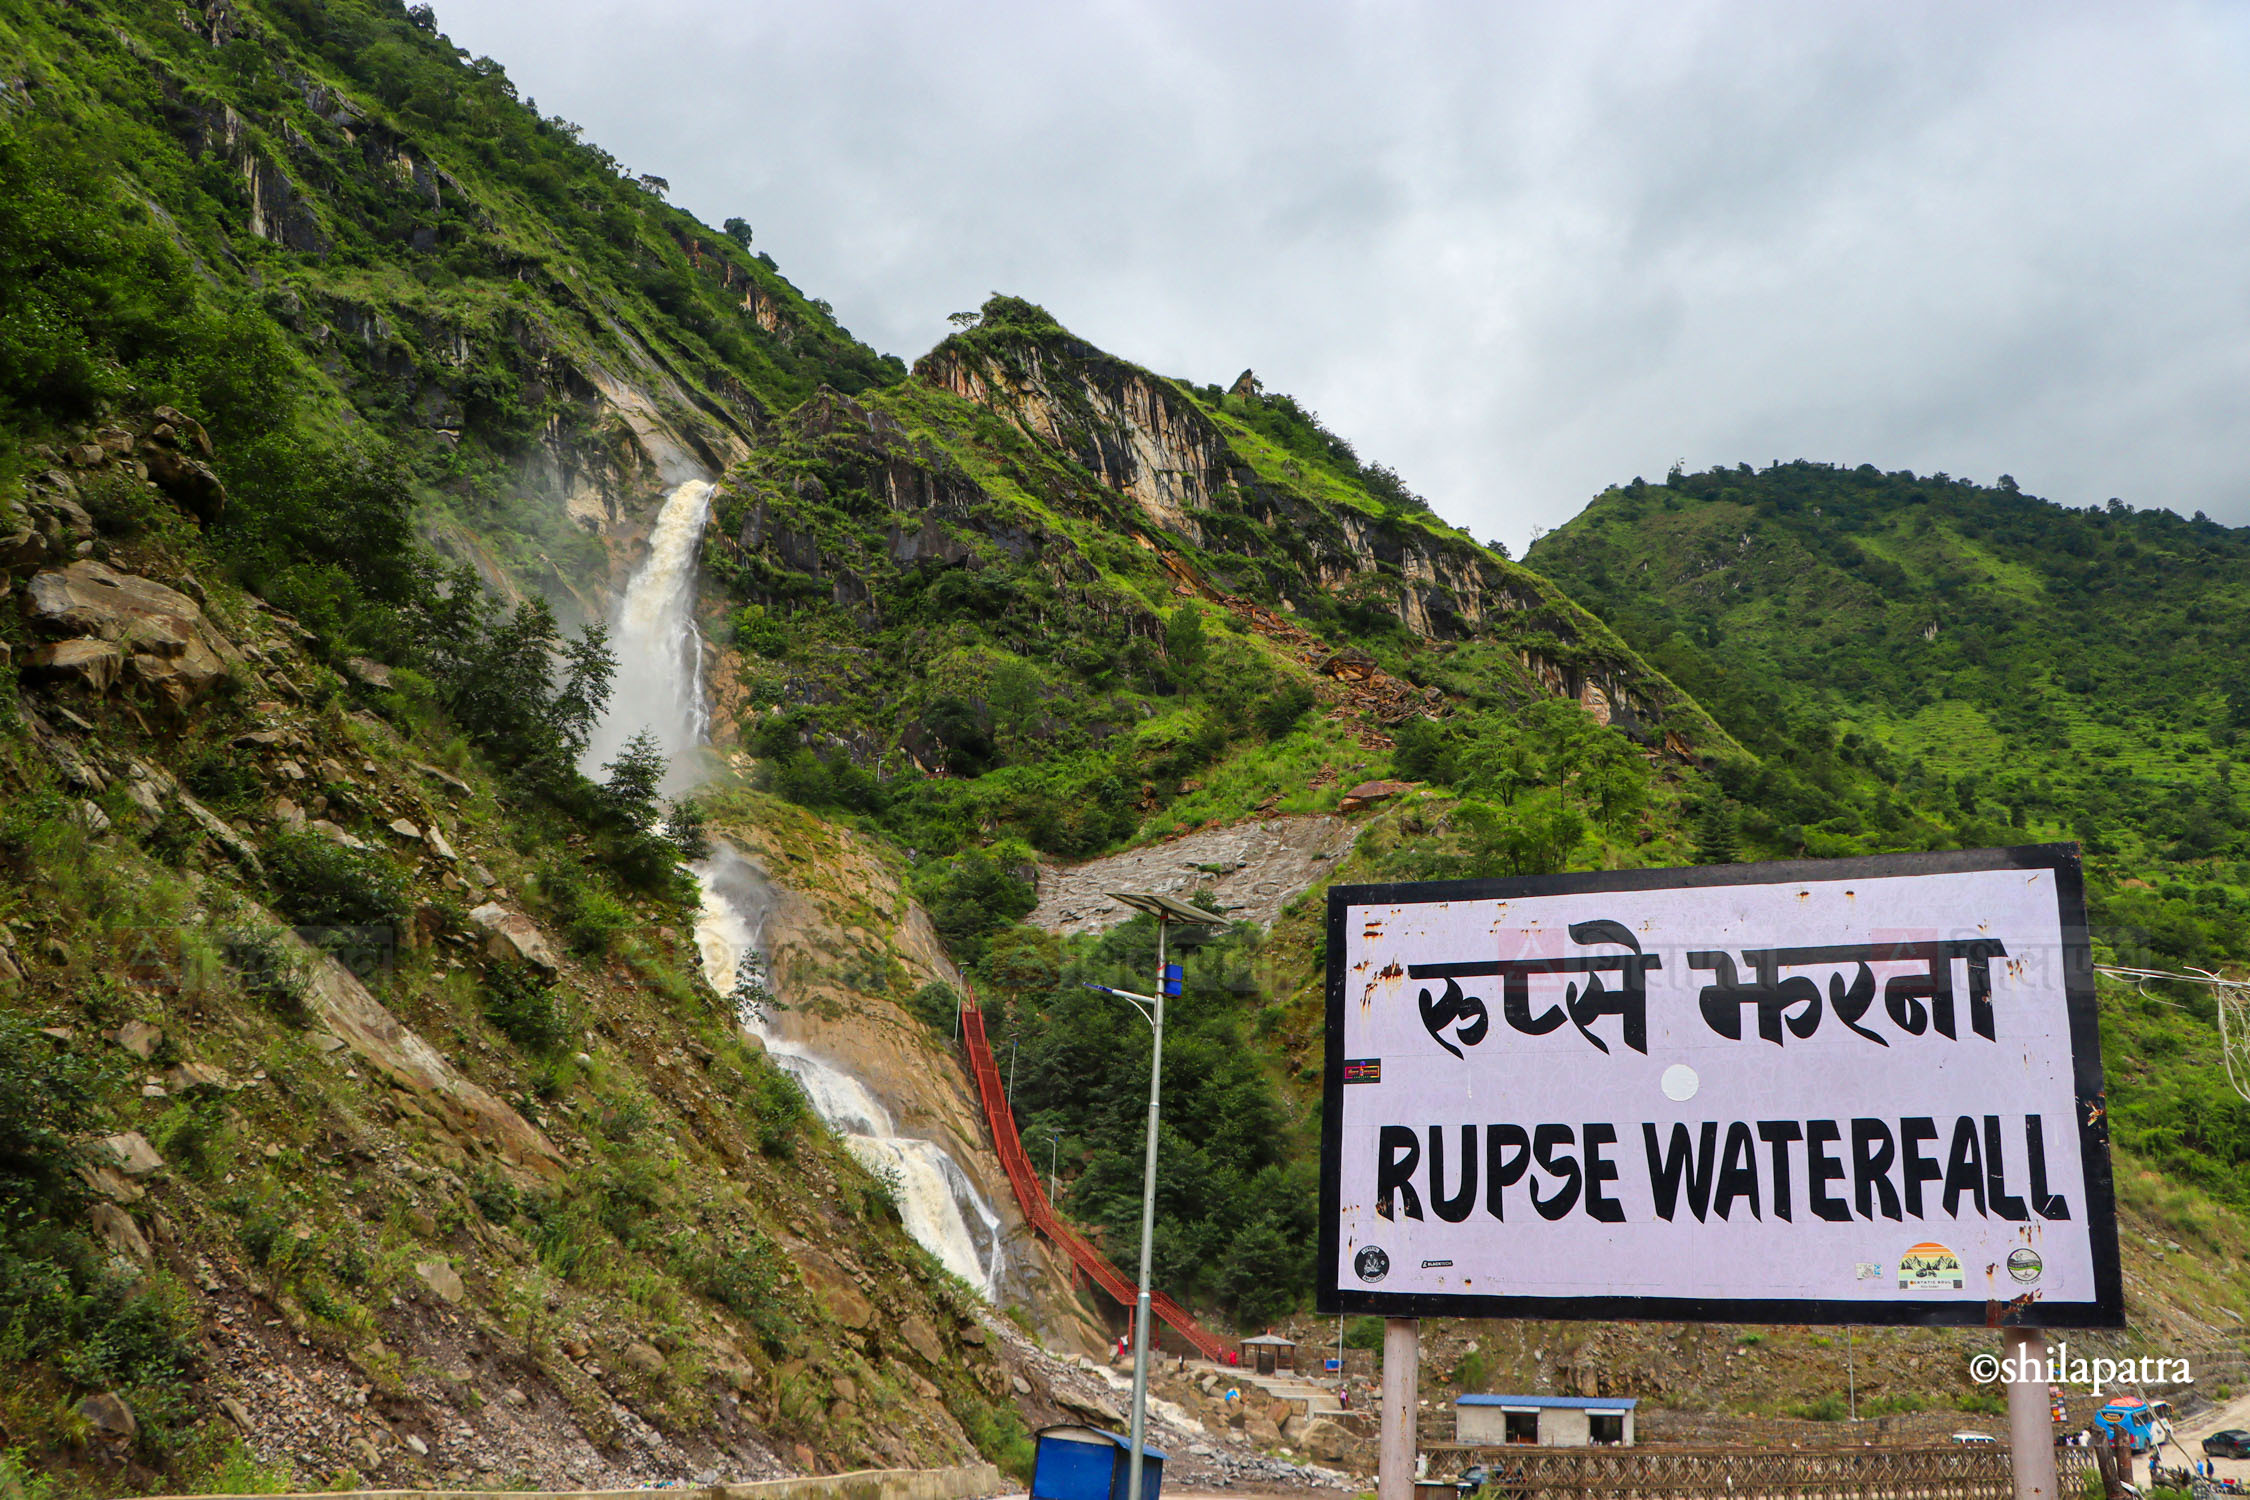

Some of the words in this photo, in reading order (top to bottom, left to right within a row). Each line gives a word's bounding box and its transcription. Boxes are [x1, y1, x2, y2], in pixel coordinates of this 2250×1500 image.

[1686, 937, 2009, 1048] झरना
[1374, 1123, 1627, 1224] RUPSE
[1642, 1114, 2072, 1225] WATERFALL
